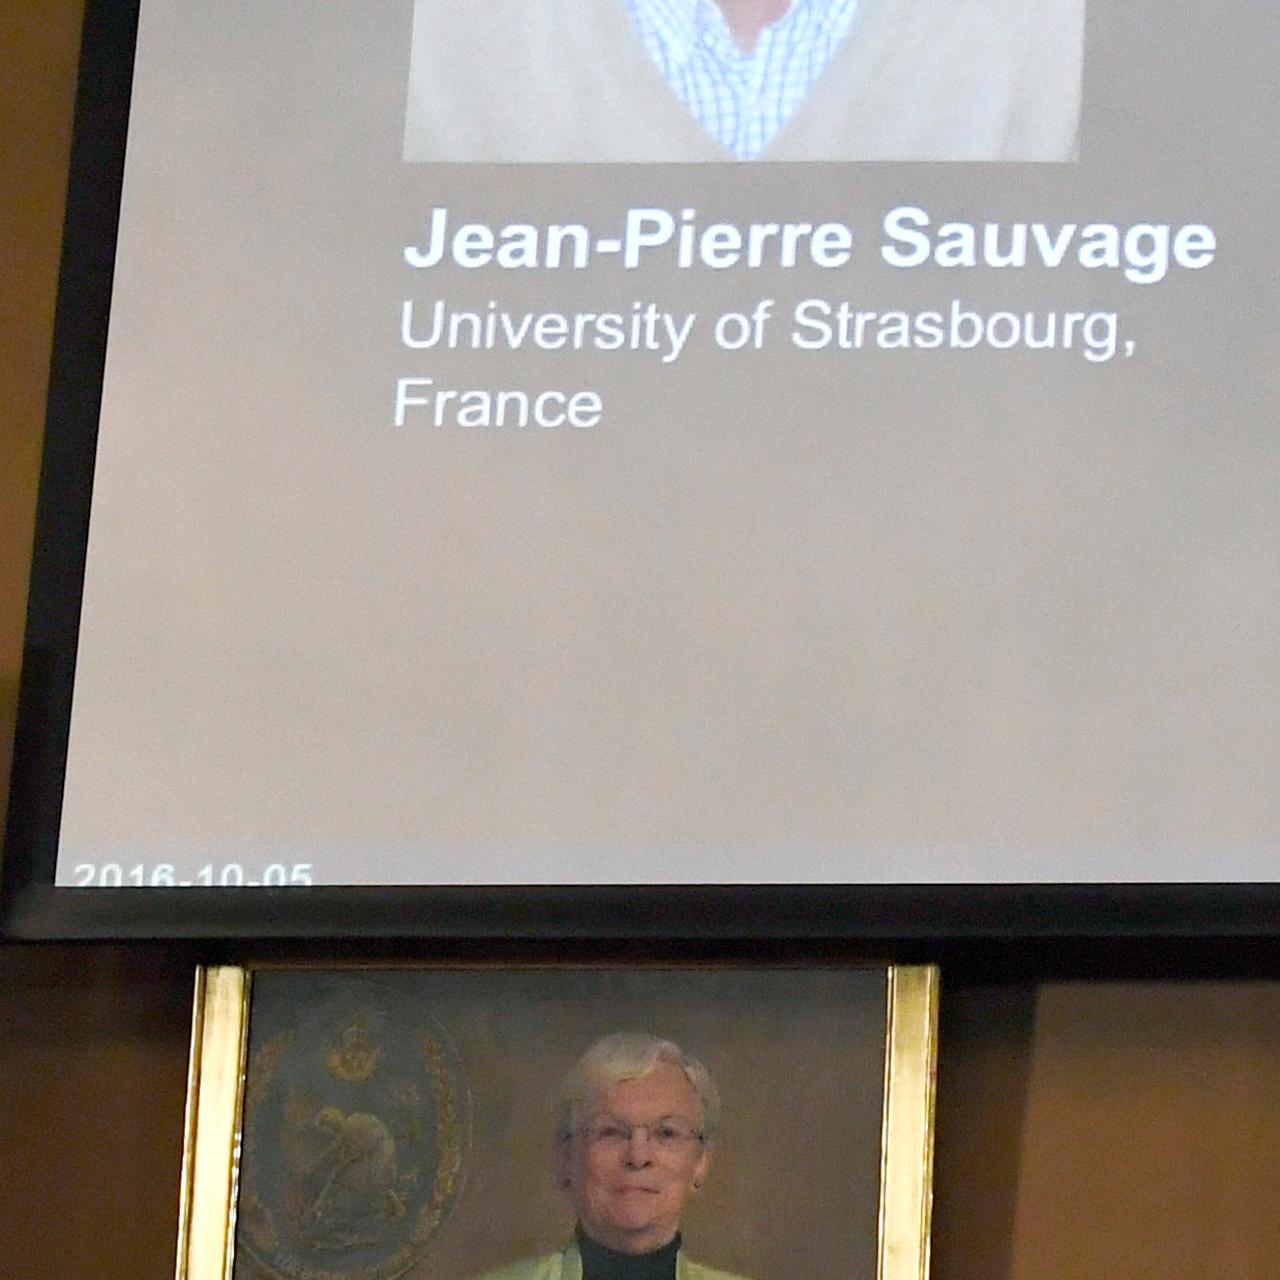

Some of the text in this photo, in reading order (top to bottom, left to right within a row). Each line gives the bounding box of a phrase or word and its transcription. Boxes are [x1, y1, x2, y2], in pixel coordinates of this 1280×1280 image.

[403, 206, 1217, 284] Jean-Pierre Sauvage
[401, 298, 1135, 363] University of Strasbourg,
[394, 377, 603, 428] France
